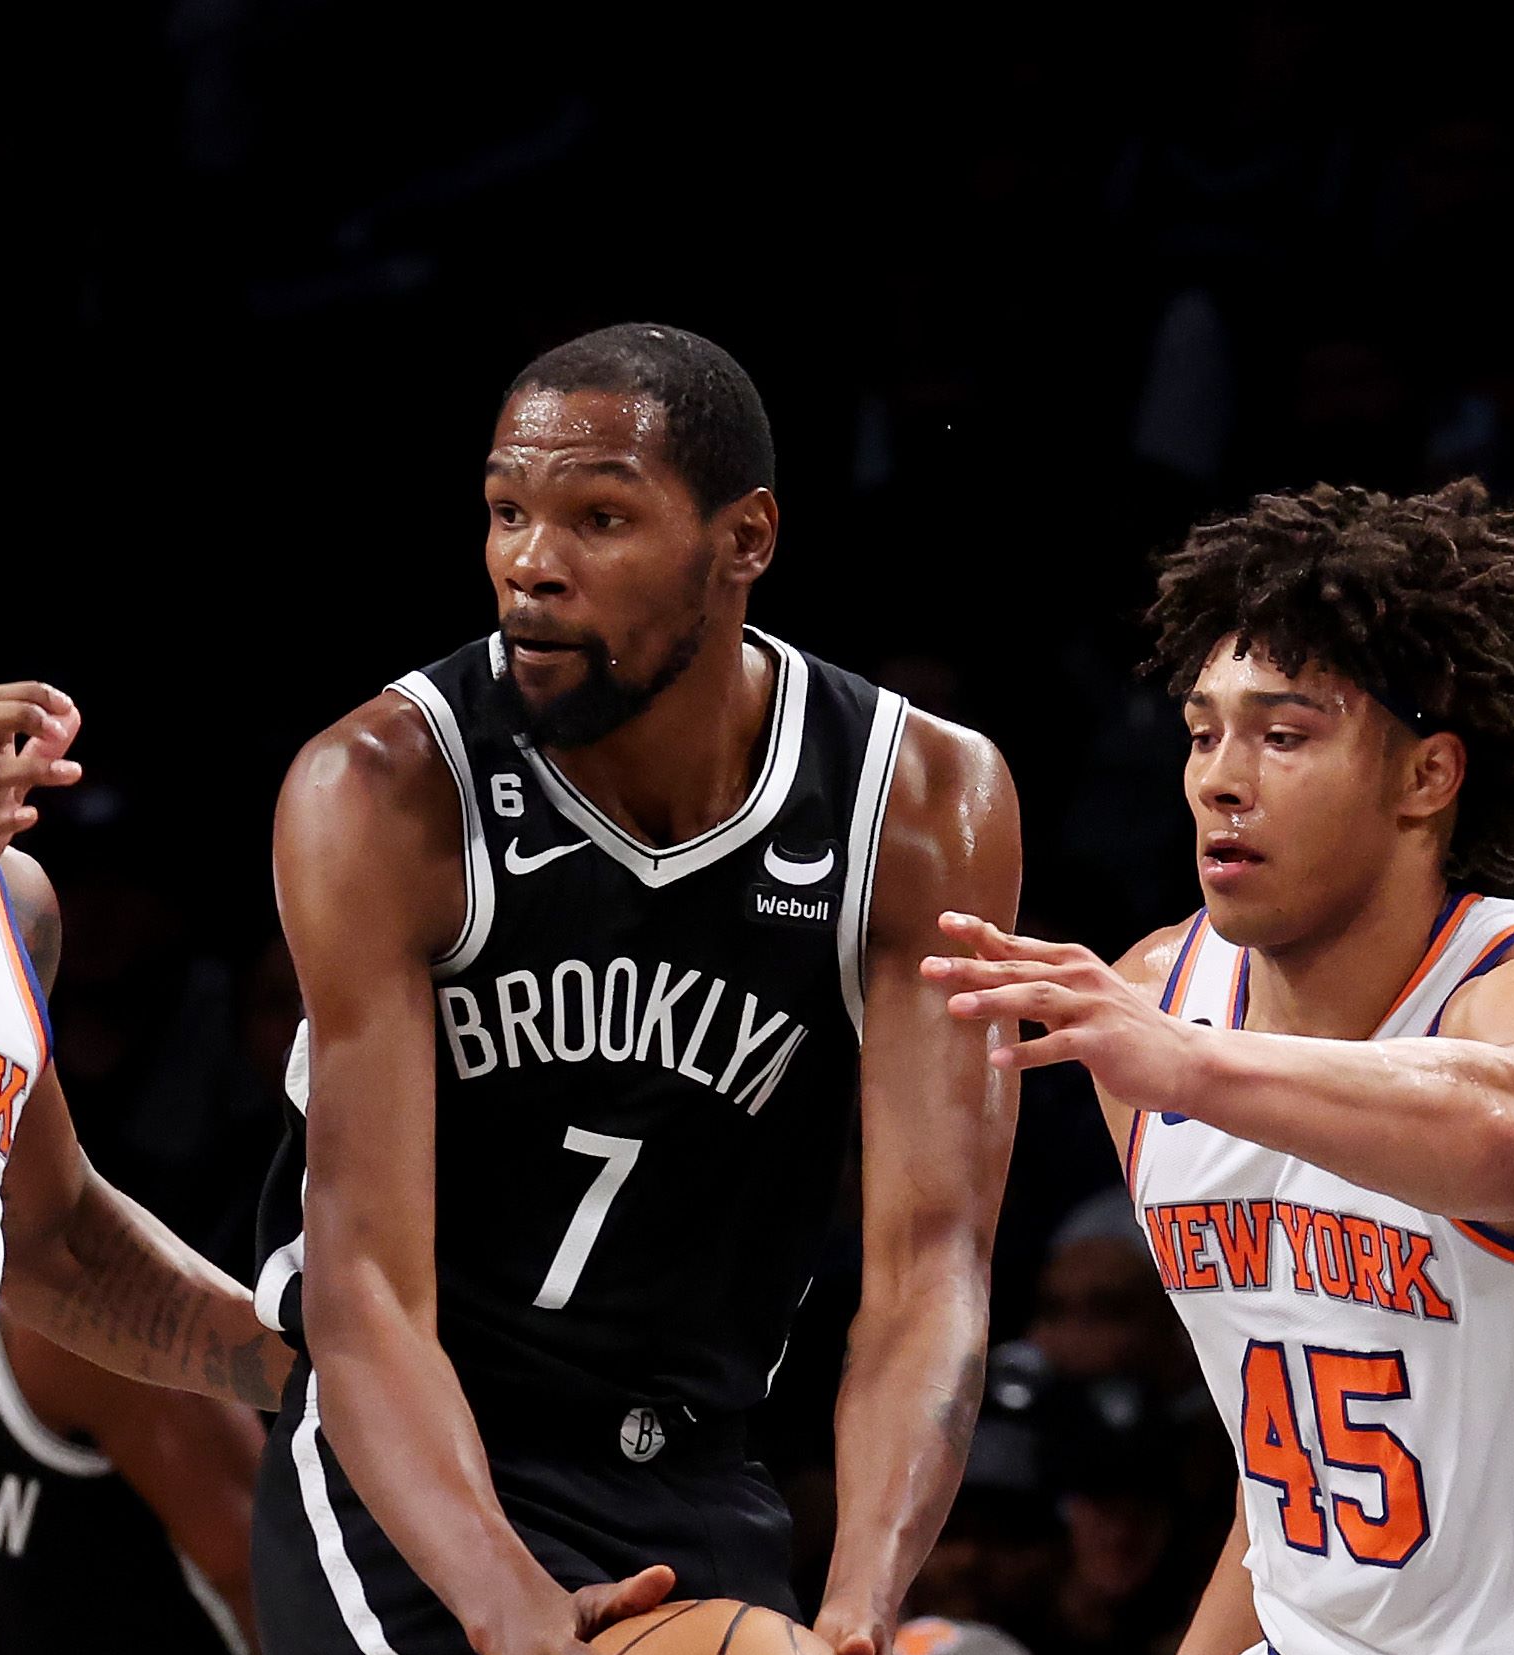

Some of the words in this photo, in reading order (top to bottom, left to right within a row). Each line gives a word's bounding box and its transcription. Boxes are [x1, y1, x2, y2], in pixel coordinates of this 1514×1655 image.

[492, 773, 525, 819] 6
[756, 894, 829, 921] Webull
[439, 957, 809, 1116] BROOKLYN
[532, 1126, 643, 1309] 7
[1143, 1199, 1274, 1293] NEW
[1275, 1200, 1458, 1323] YORK
[634, 1410, 655, 1455] B
[1241, 1338, 1431, 1569] 45
